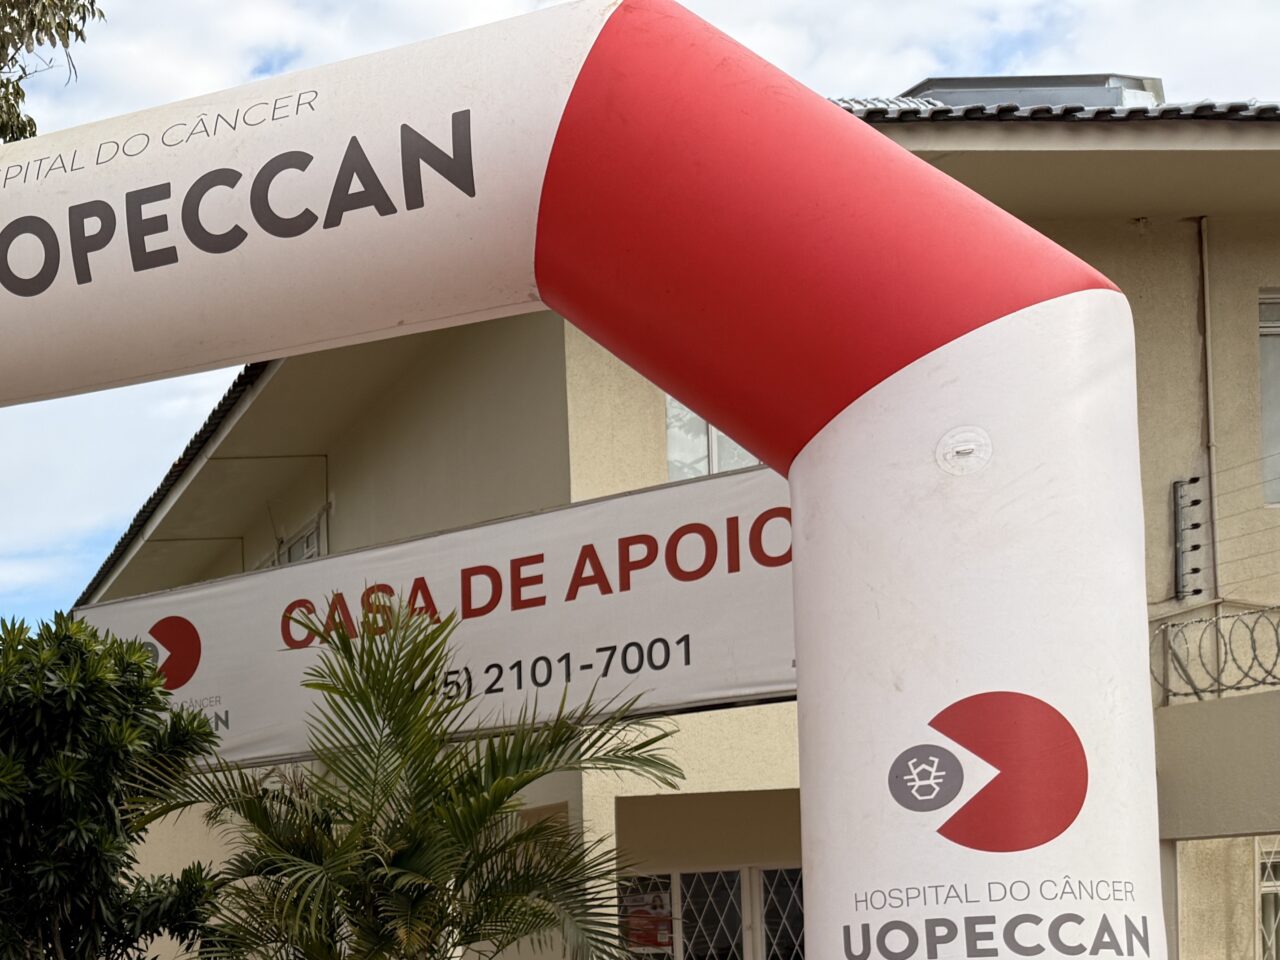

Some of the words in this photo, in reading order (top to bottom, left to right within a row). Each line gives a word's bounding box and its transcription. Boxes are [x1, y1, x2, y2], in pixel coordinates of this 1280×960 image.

[95, 132, 151, 166] DO
[160, 89, 319, 148] CÂNCER
[280, 576, 442, 650] CASA
[460, 553, 547, 621] DE
[563, 506, 793, 602] APOIO
[483, 633, 691, 695] 2101-7001
[853, 882, 980, 912] HOSPITAL
[987, 879, 1031, 903] DO
[1038, 875, 1136, 903] CÂNCER
